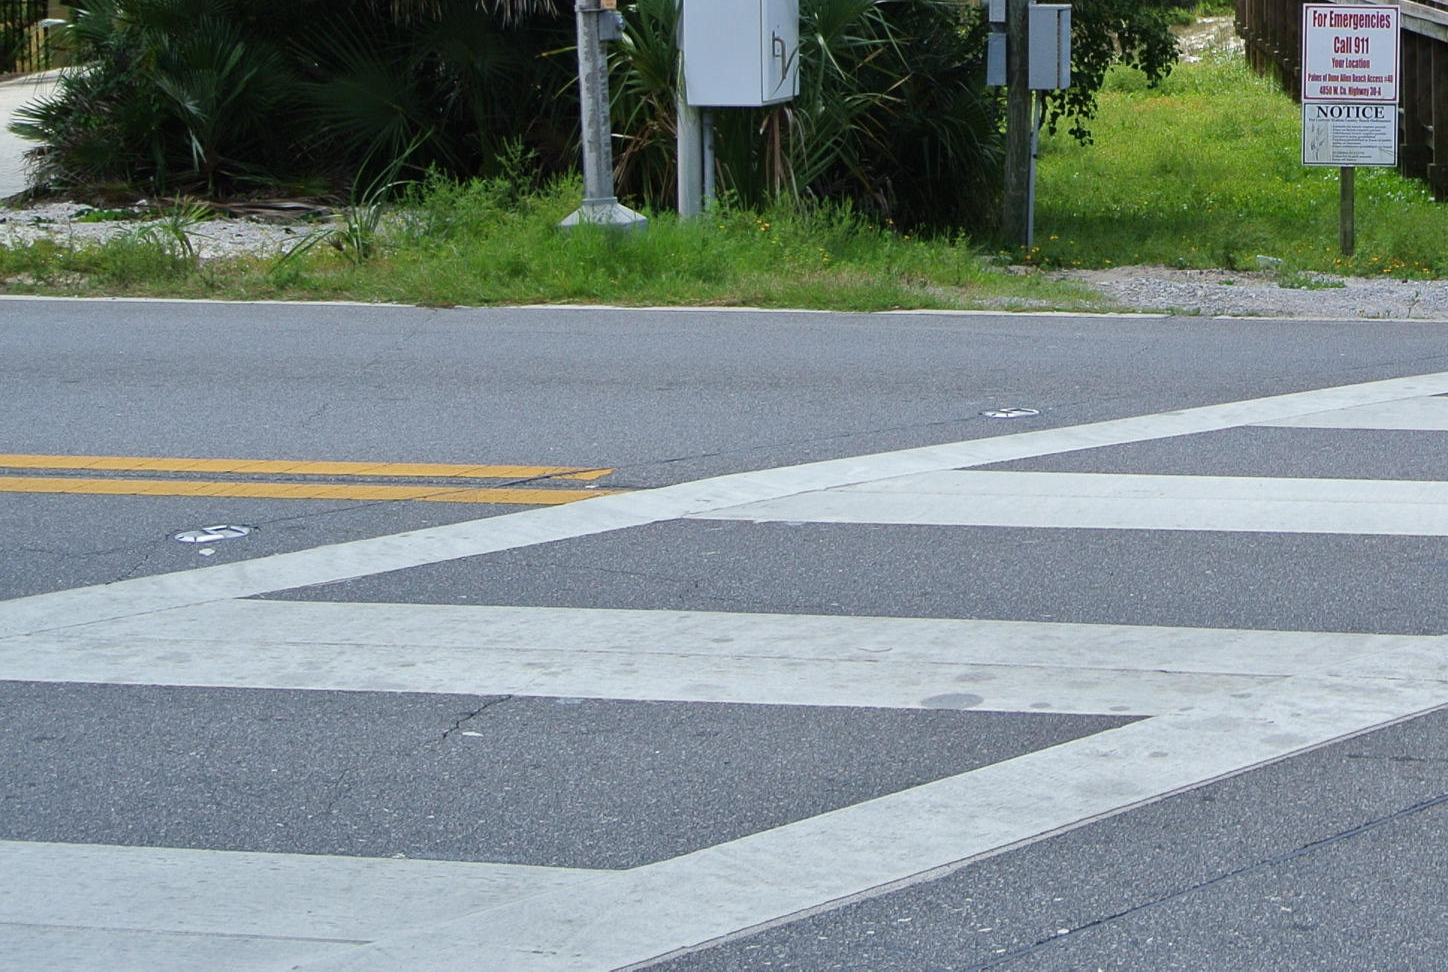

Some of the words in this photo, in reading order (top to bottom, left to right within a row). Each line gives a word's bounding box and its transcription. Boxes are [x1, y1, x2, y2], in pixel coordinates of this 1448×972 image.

[1312, 10, 1327, 28] For
[1329, 11, 1391, 30] Emergencies
[1333, 36, 1352, 54] Call
[1354, 36, 1370, 54] 911
[1331, 57, 1345, 69] Your
[1345, 57, 1371, 69] Location
[1322, 73, 1328, 82] of
[1328, 73, 1339, 82] Dune
[1340, 73, 1351, 82] Allen
[1352, 73, 1366, 83] Beach
[1367, 74, 1383, 83] Access
[1348, 86, 1369, 96] Highway
[1316, 106, 1385, 119] NOTICE
